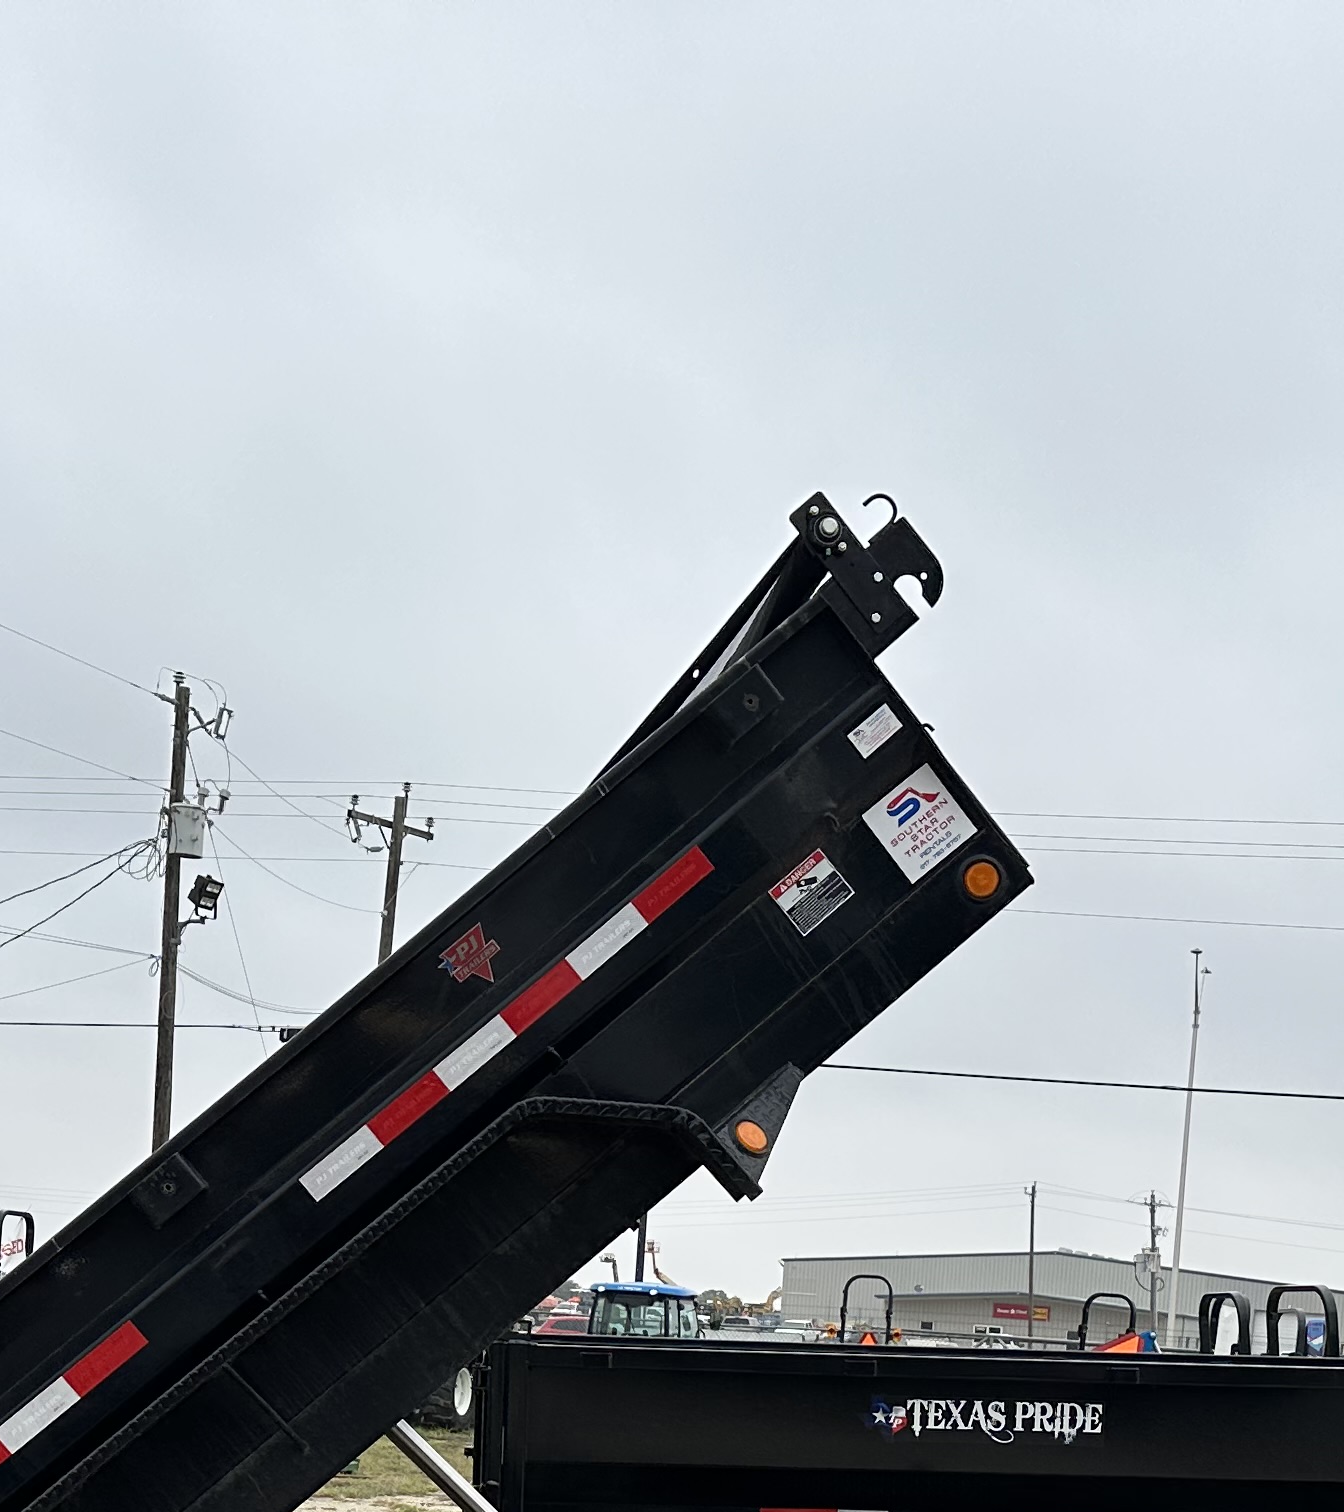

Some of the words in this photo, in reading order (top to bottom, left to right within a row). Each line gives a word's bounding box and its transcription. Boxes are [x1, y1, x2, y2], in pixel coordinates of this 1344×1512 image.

[890, 797, 948, 847] SOUTHERN
[904, 815, 956, 857] TRACTOR
[910, 817, 939, 842] STAR
[919, 831, 952, 858] RENTALS
[785, 858, 816, 887] DANGER
[456, 935, 478, 960] PJ
[458, 944, 496, 978] TRAILERS
[906, 1399, 1014, 1444] TEXAS
[1013, 1401, 1103, 1445] PRIDE
